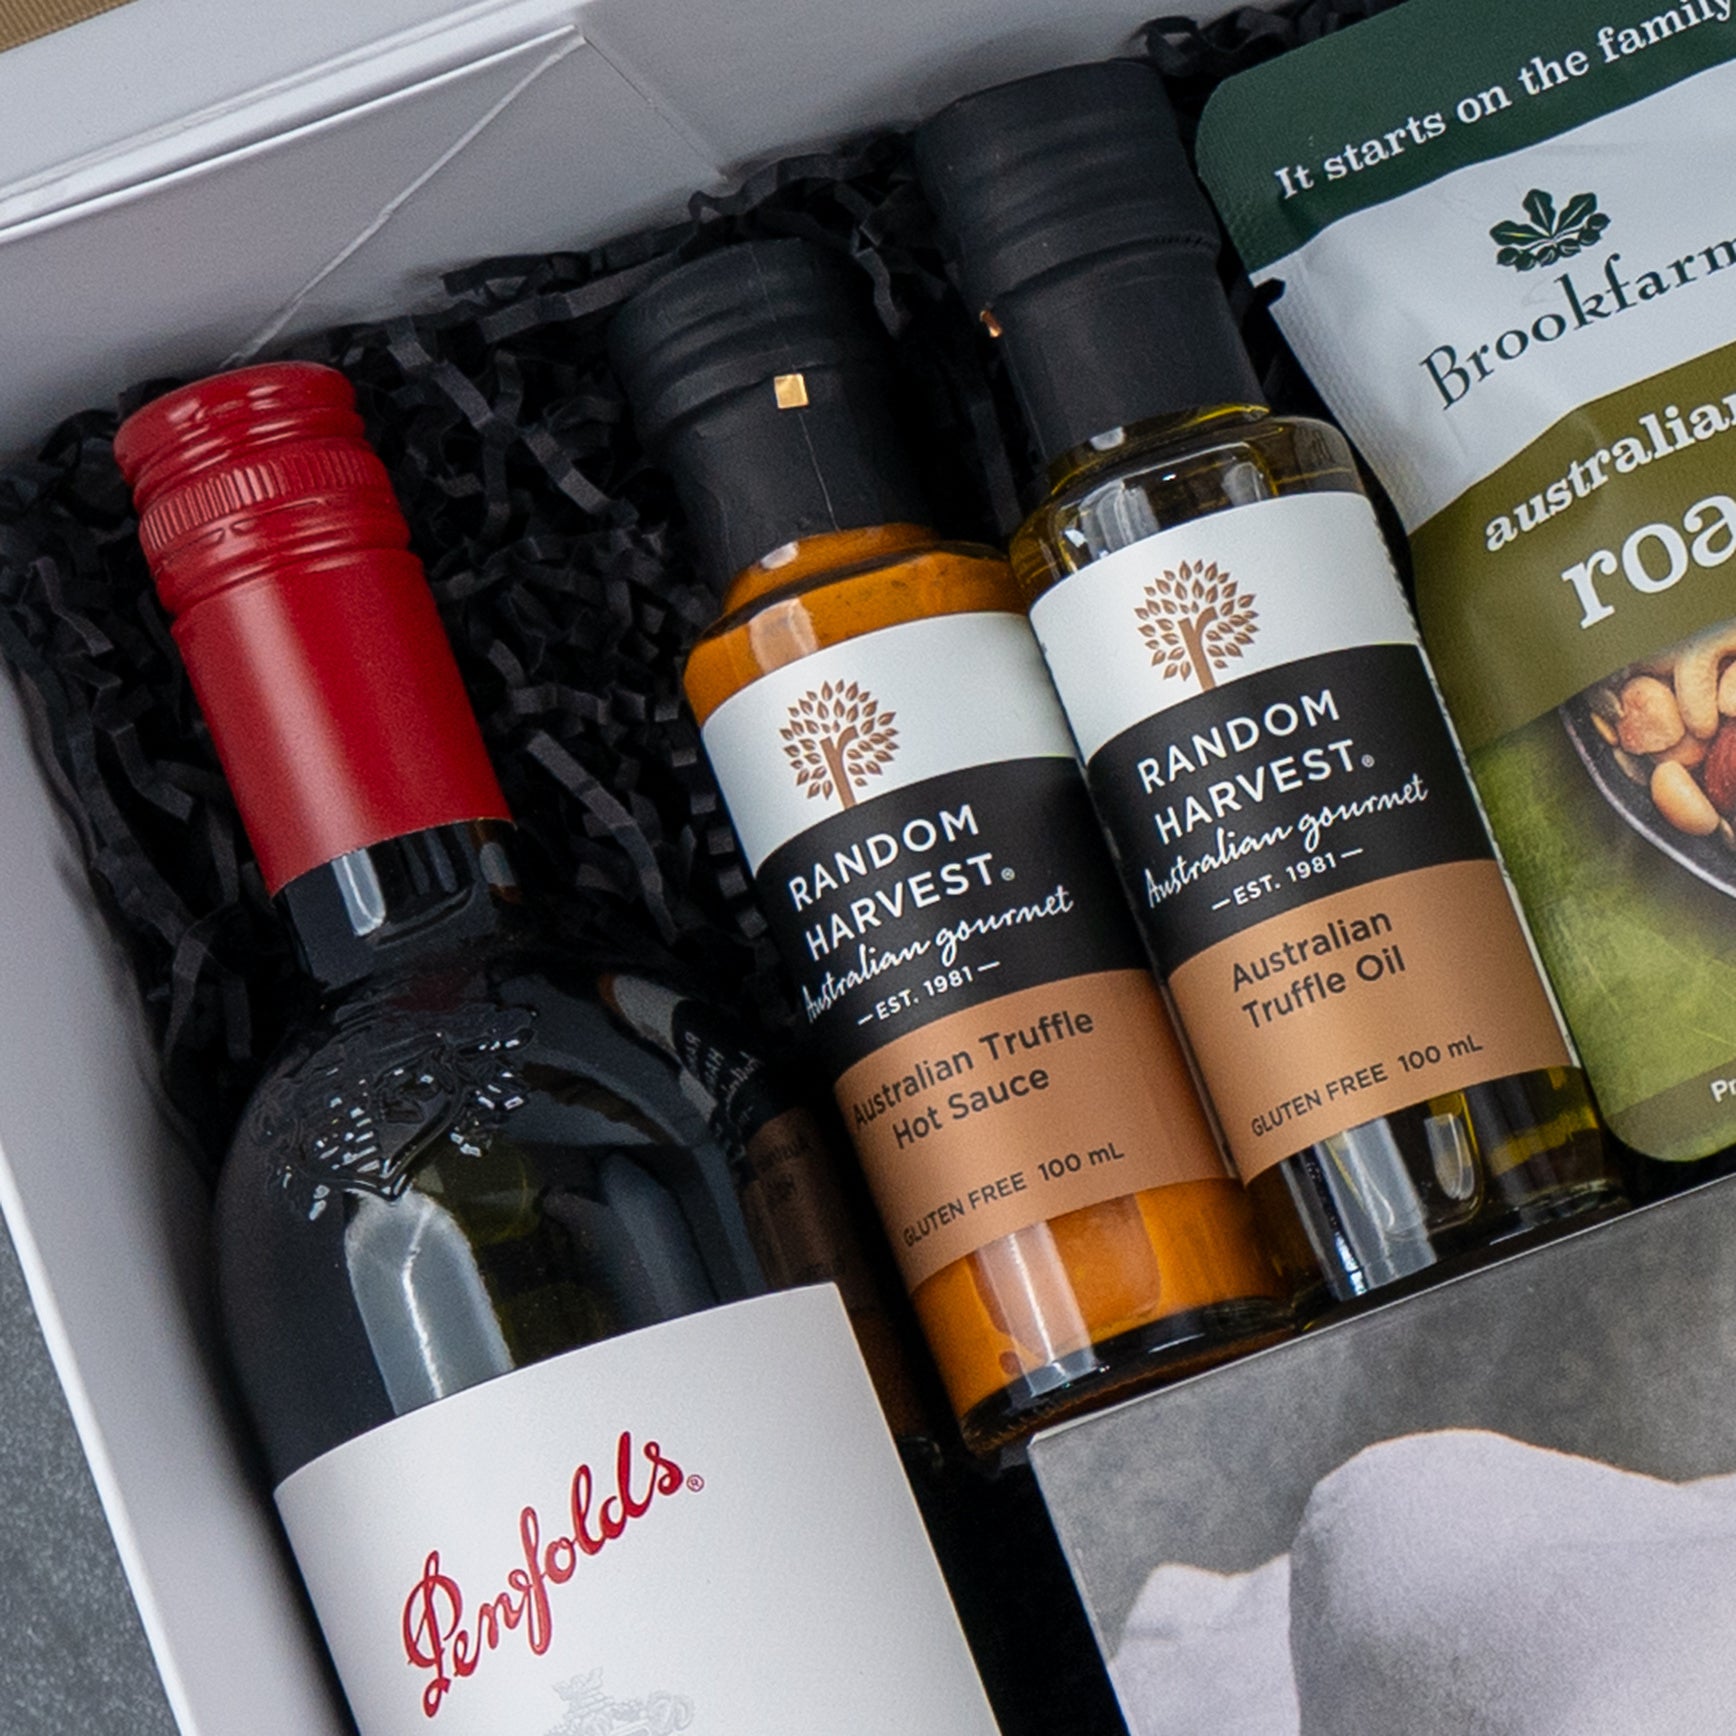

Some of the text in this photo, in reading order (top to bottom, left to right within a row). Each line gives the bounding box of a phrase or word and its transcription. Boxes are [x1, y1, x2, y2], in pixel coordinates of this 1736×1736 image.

[1274, 161, 1314, 200] It
[1322, 108, 1447, 183] starts
[1456, 82, 1513, 126] on
[1517, 50, 1591, 97] the
[1136, 688, 1341, 795] RANDOM
[788, 803, 980, 913] RANDOM
[1144, 772, 1429, 909] Australian gourmet
[1285, 852, 1337, 884] 1981
[801, 884, 1075, 1024] Australian gourmet
[923, 965, 974, 997] 1981
[1232, 912, 1393, 993] Australian
[1241, 944, 1406, 1029] Truffle Oil
[851, 1010, 1095, 1130] Australian Truffle
[891, 1067, 1050, 1150] Hot Sauce
[1251, 1034, 1484, 1138] GLUTEN FREE 100 mL
[903, 1141, 1125, 1248] GLUTEN FREE 100 mL
